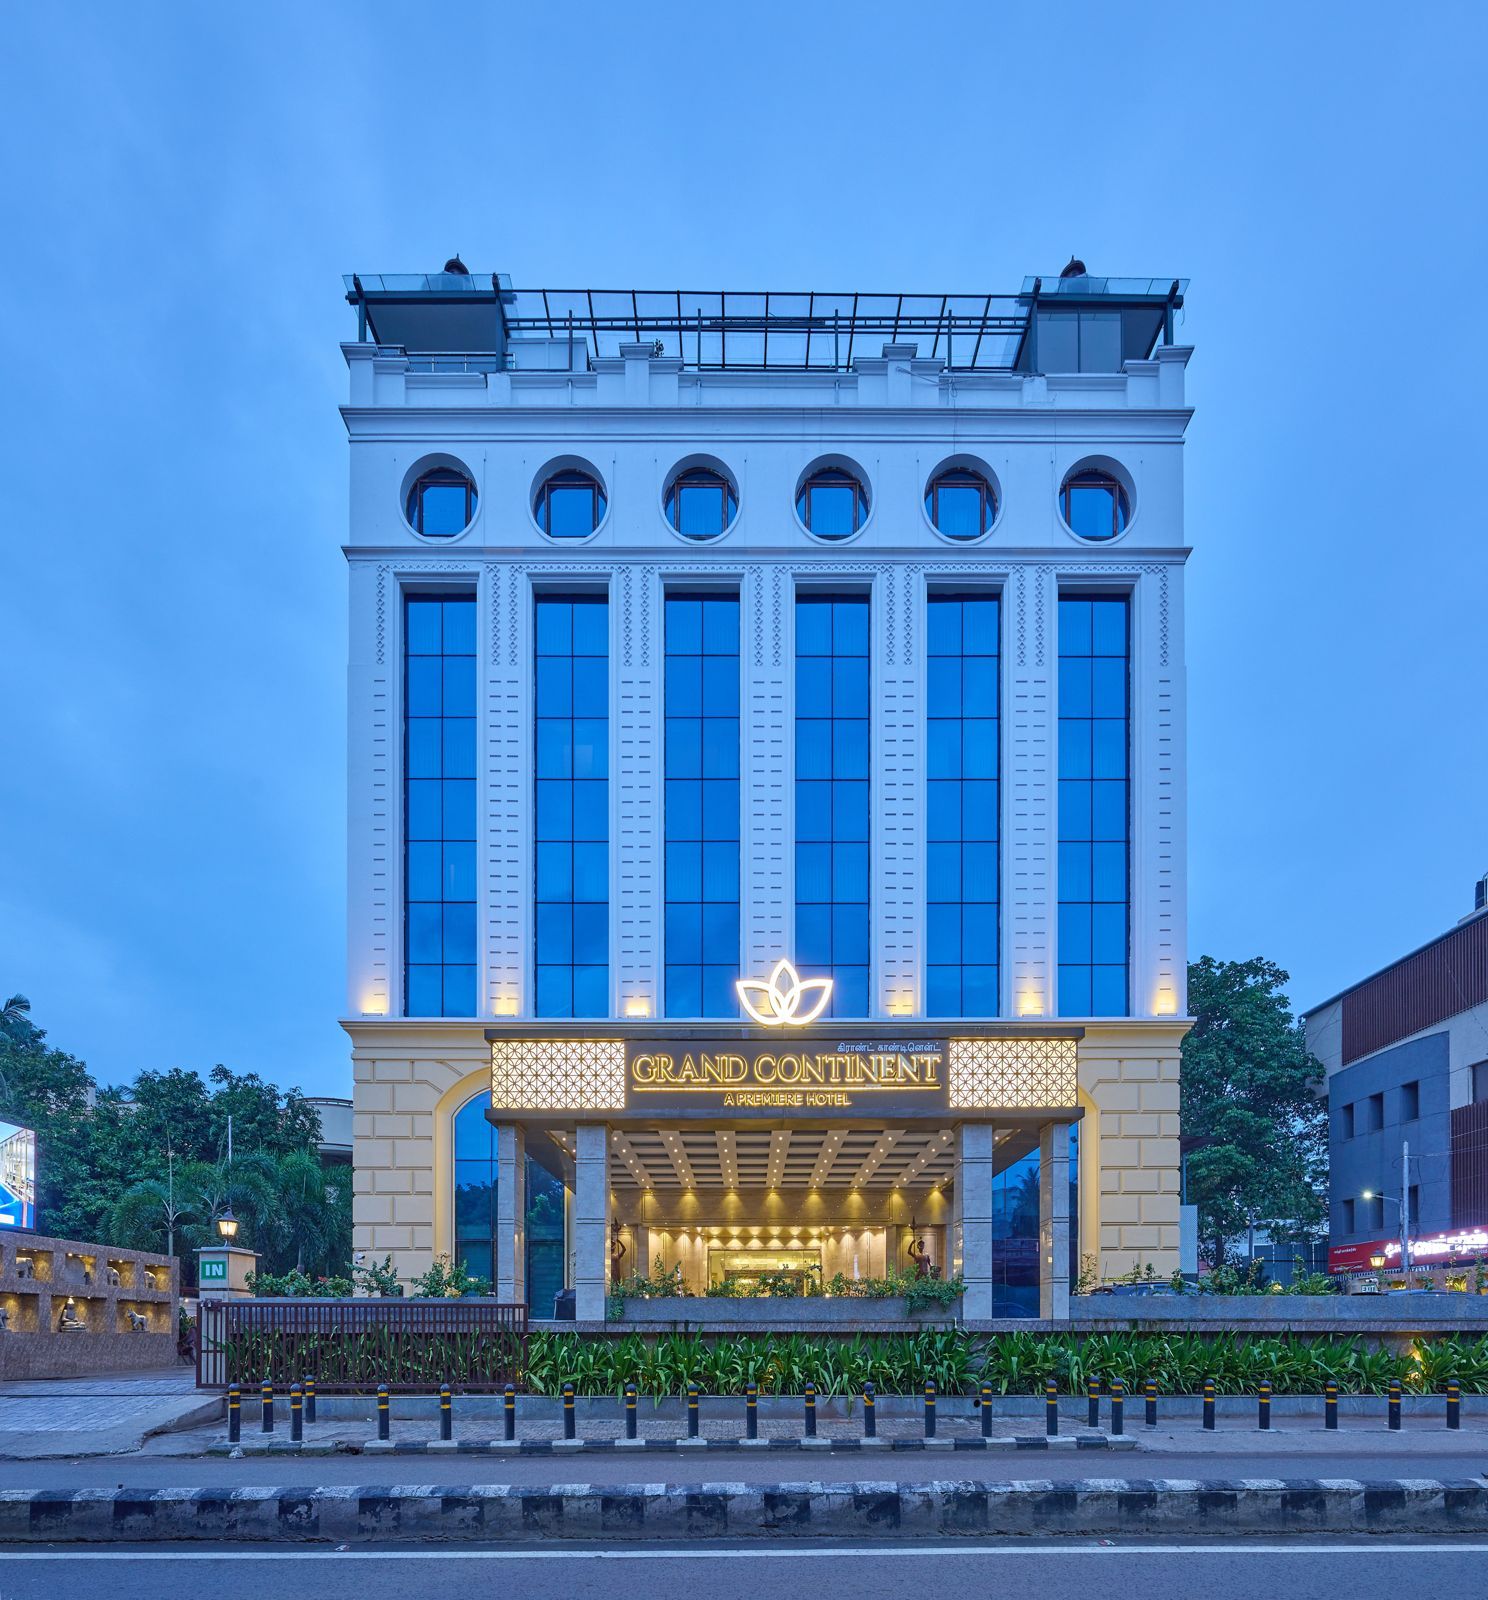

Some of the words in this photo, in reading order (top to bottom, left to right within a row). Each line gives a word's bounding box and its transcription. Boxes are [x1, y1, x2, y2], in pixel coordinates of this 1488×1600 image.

[632, 1053, 748, 1083] GRAND
[753, 1053, 943, 1083] CONTINENT
[723, 1093, 735, 1106] A
[736, 1093, 804, 1106] PREMIERE
[806, 1093, 852, 1106] HOTEL
[205, 1264, 223, 1276] IN
